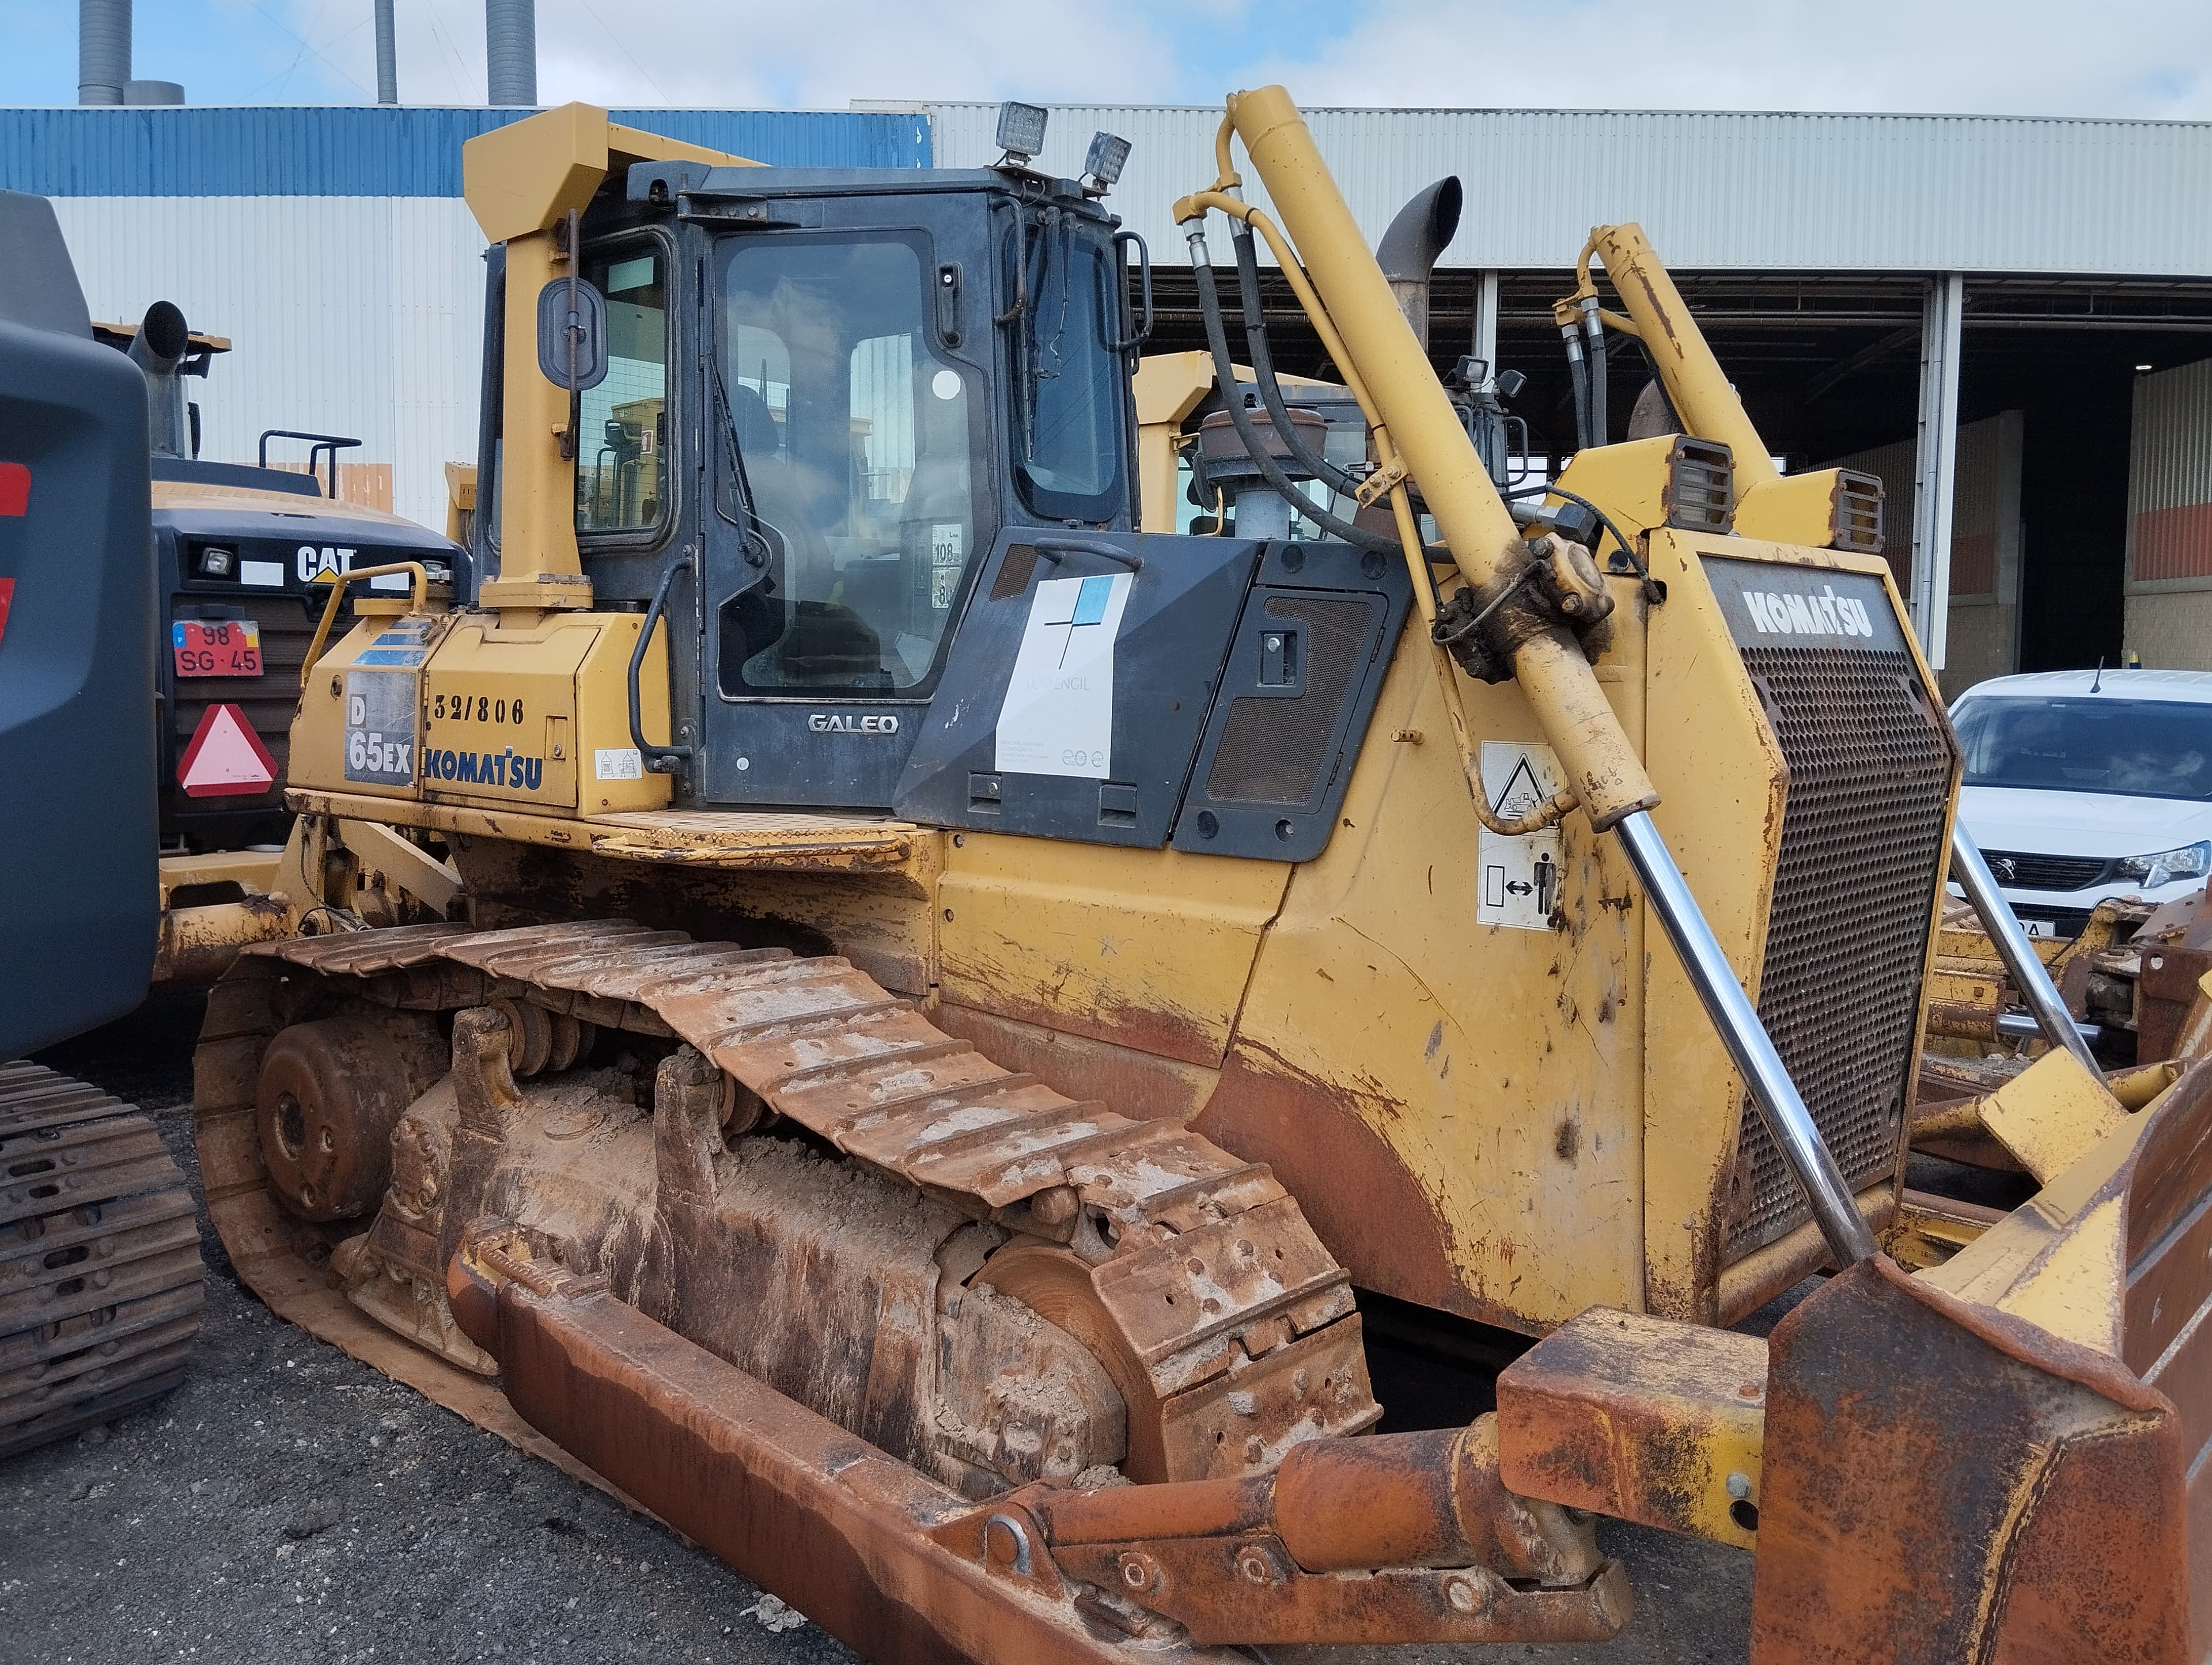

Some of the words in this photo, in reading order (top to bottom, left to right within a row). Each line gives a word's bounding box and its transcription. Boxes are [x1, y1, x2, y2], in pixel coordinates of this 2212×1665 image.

[297, 546, 354, 582] CAT
[1743, 585, 1873, 637] KOMATSU
[203, 626, 230, 645] 98
[352, 696, 365, 725] D
[434, 695, 524, 725] 32/806
[808, 714, 899, 733] GALEO
[425, 746, 543, 790] KOMATSU
